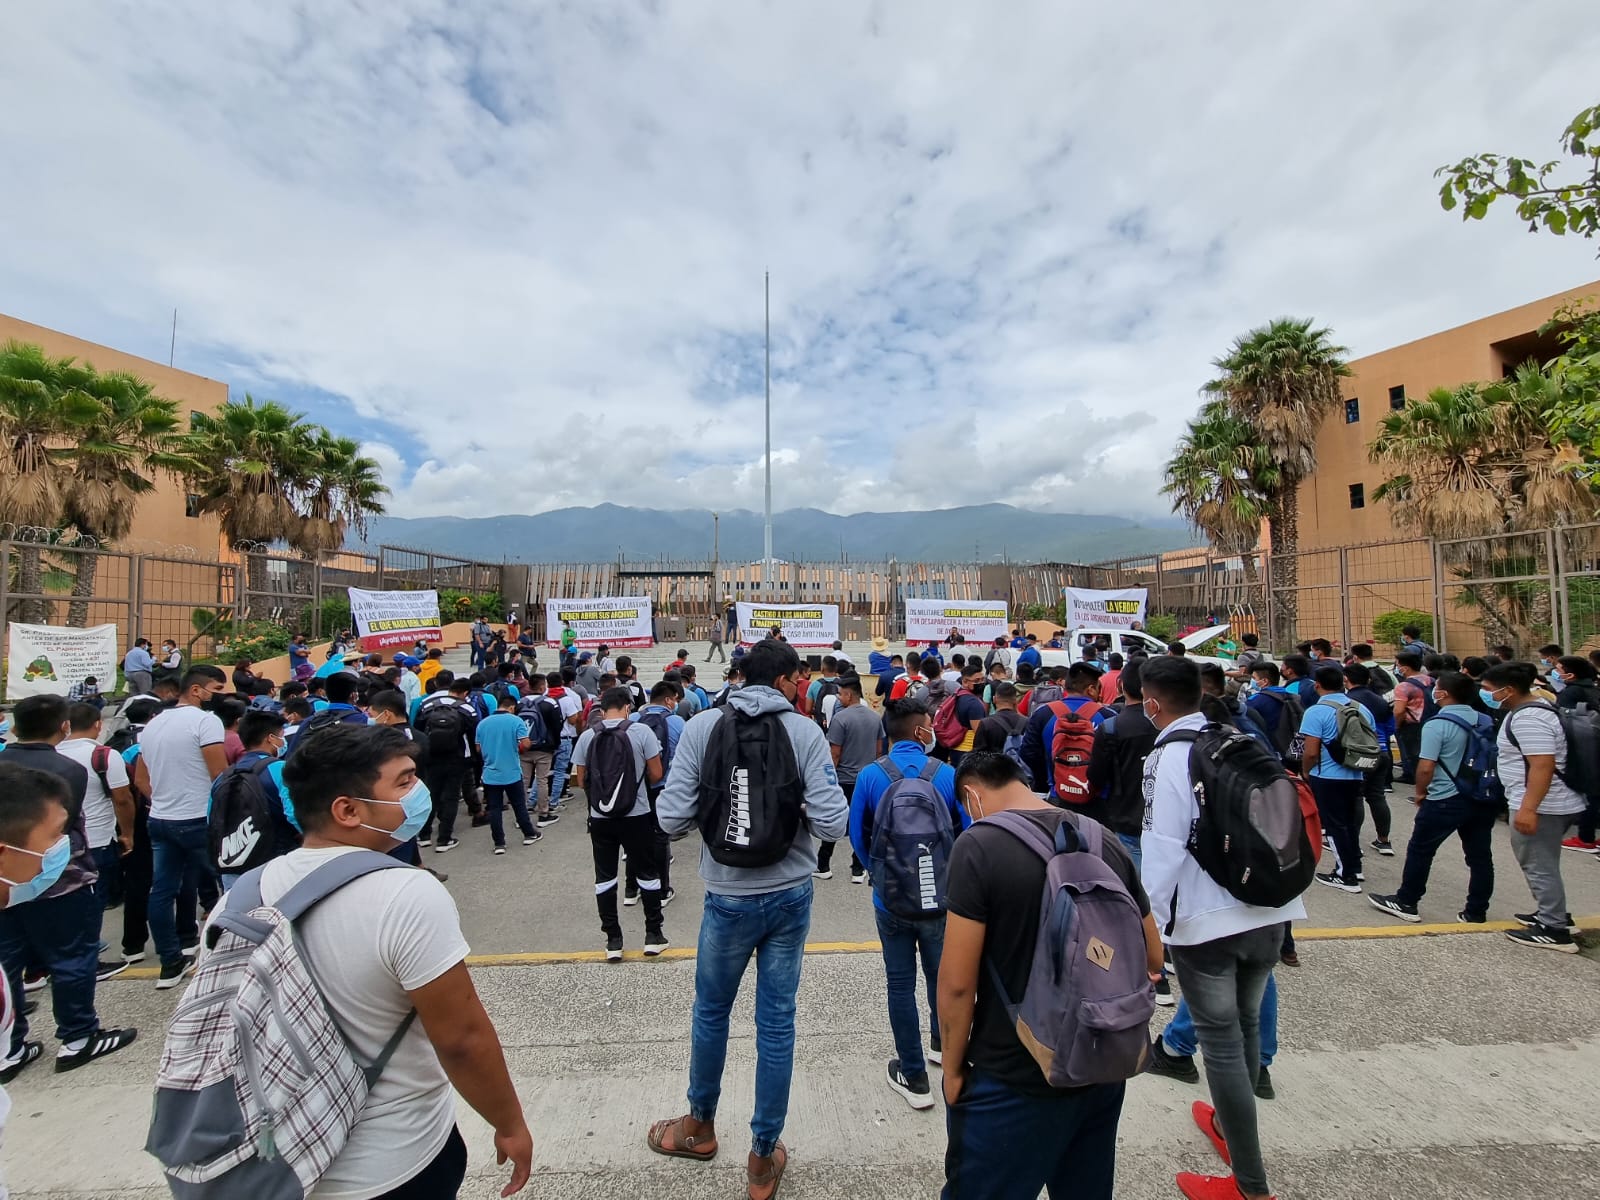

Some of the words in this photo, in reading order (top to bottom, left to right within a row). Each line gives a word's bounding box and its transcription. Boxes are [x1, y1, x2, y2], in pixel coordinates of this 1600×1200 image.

[584, 602, 614, 610] MEXICANO
[1106, 602, 1114, 612] LA
[1115, 602, 1139, 613] VERDAD
[560, 612, 580, 620] DEBEN
[610, 610, 637, 618] ARCHIVOS
[754, 610, 776, 618] CASTIGO
[793, 611, 822, 619] MILITARES
[370, 622, 380, 631] EL
[380, 621, 392, 630] QUE
[580, 620, 606, 628] CONOCER
[793, 620, 824, 628] OCULTARON
[580, 630, 595, 638] CASO
[596, 630, 630, 638] AYOTZINAPA
[787, 630, 800, 638] CASO
[1355, 757, 1377, 768] NIKE
[1060, 784, 1082, 794] PUMA
[222, 816, 254, 860] NIKE
[918, 855, 938, 909] PUMA
